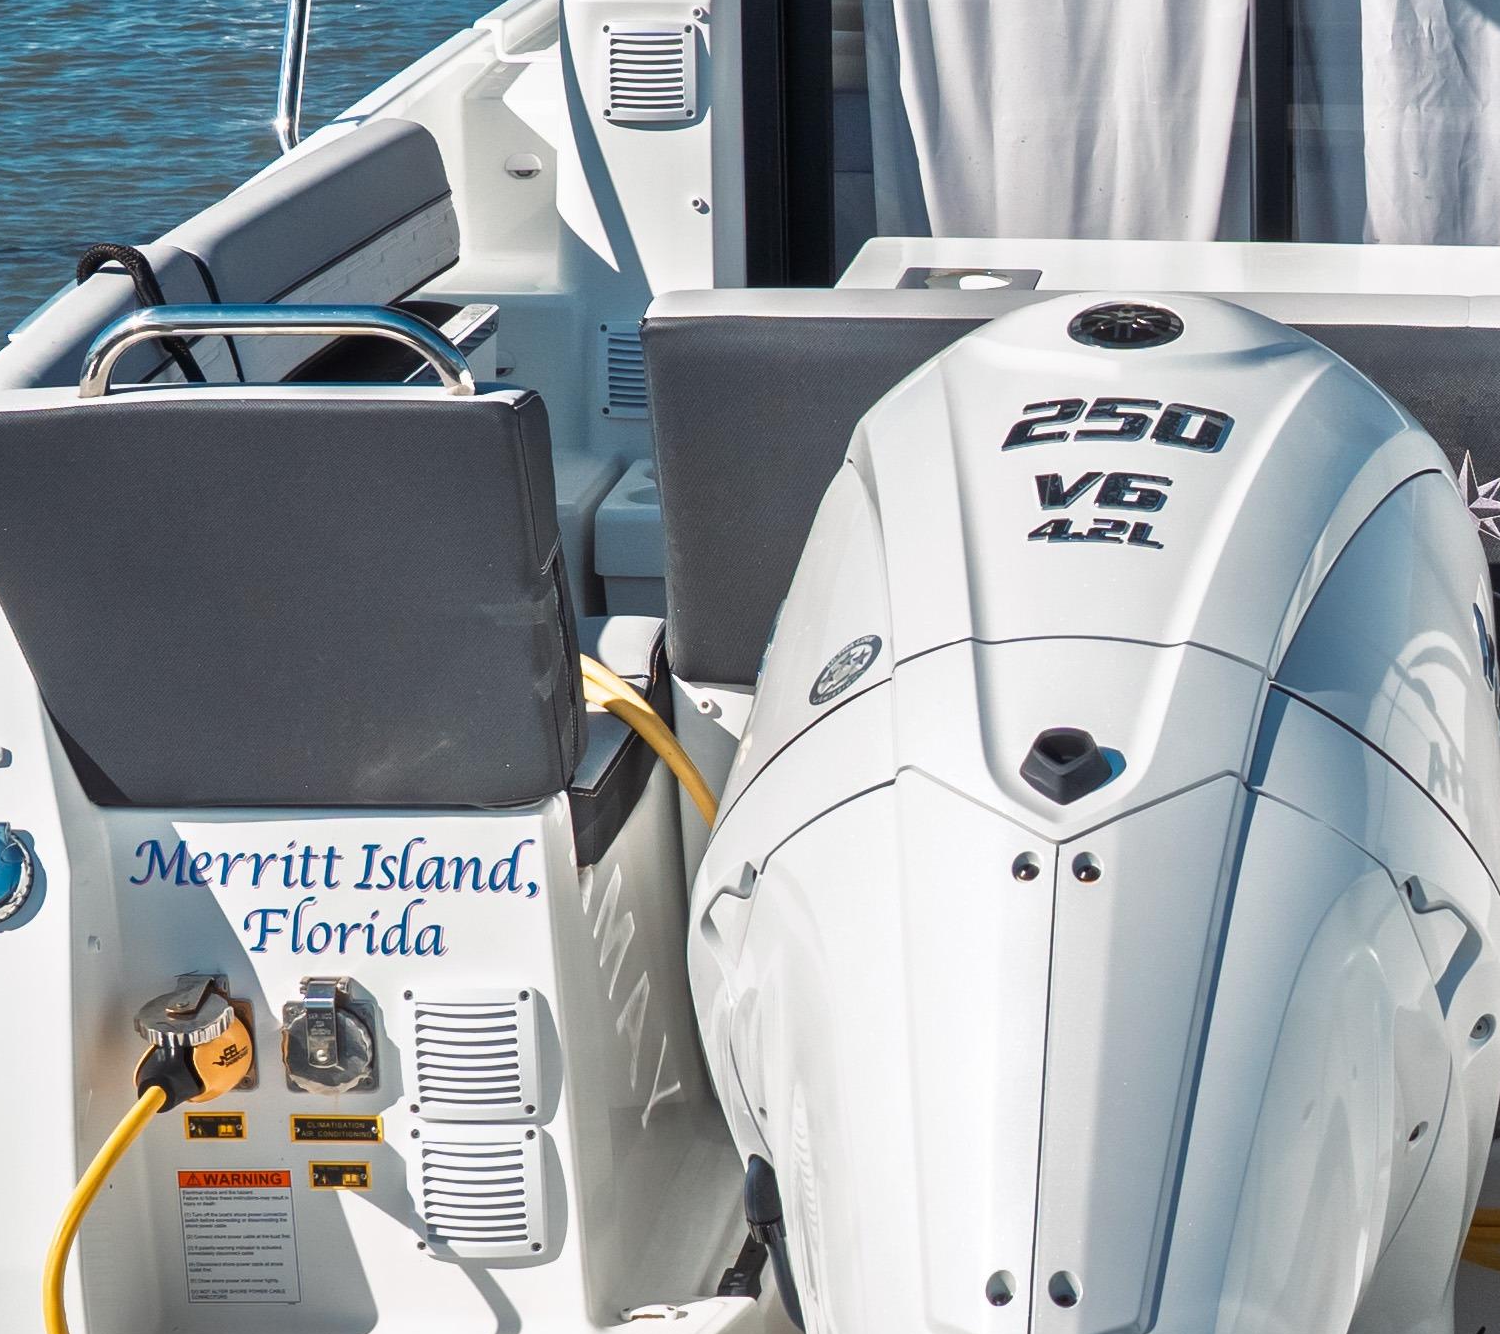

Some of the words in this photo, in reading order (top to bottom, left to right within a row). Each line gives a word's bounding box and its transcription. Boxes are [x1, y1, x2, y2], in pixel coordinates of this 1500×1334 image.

[1001, 397, 1236, 454] 250
[1035, 471, 1173, 512] V6
[1027, 518, 1164, 549] 4.2L
[130, 839, 344, 890] Merritt
[354, 837, 541, 899] Island,
[244, 896, 448, 957] Florida
[203, 1173, 282, 1185] WARNING
